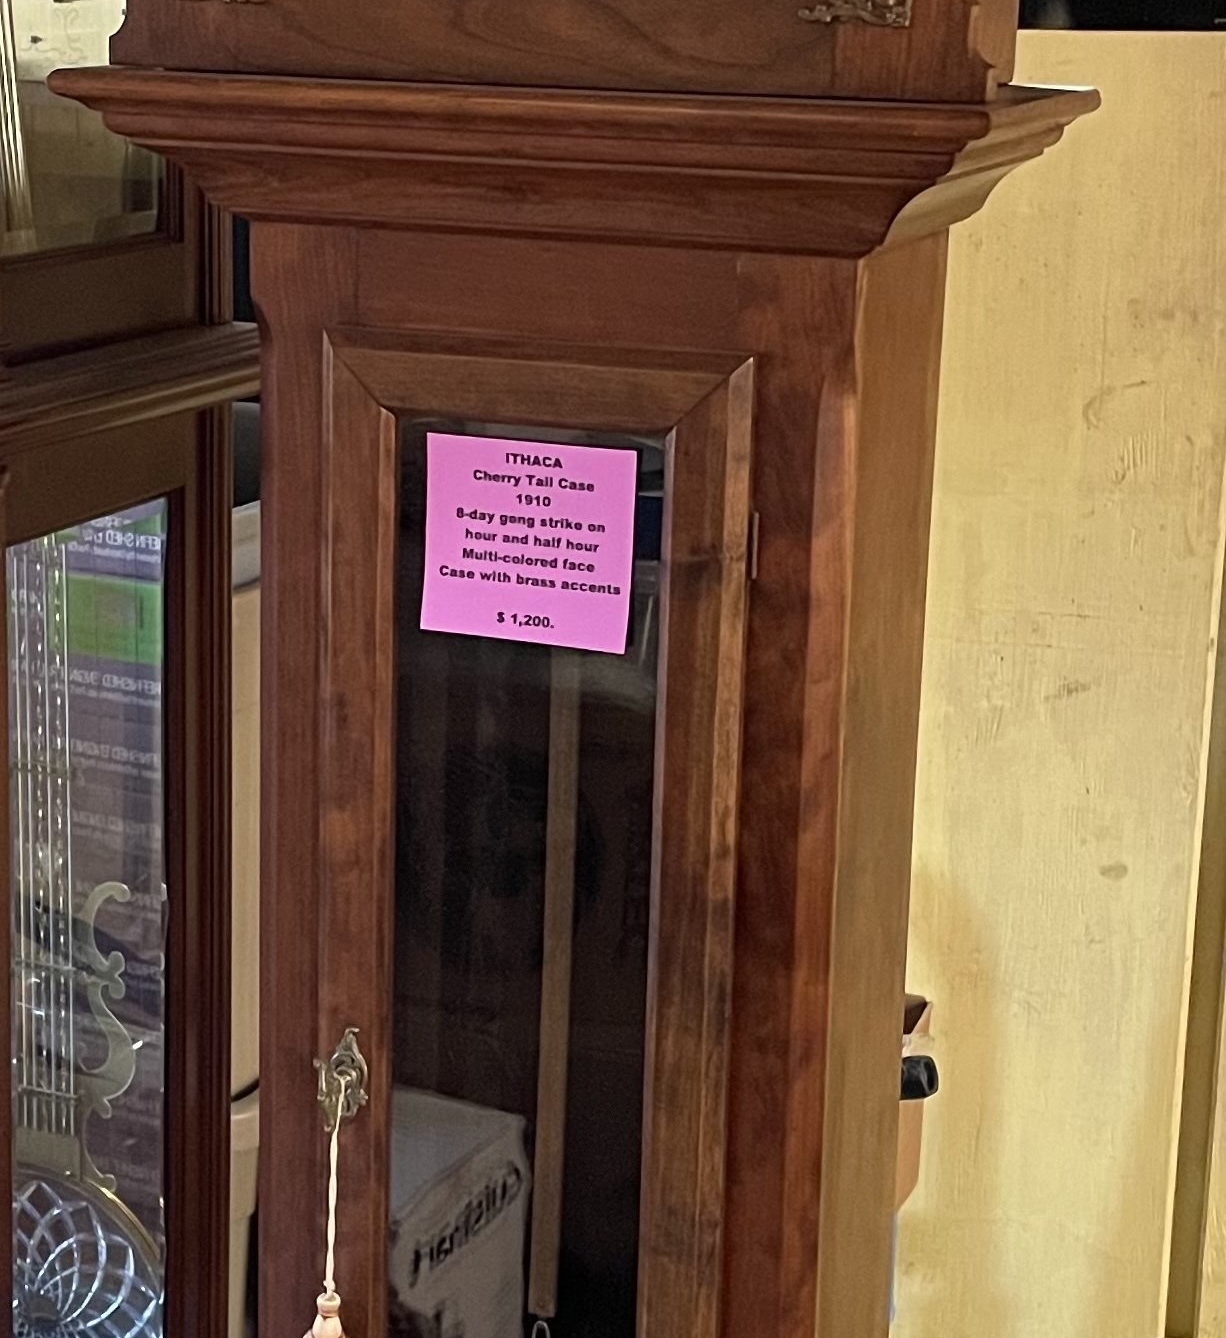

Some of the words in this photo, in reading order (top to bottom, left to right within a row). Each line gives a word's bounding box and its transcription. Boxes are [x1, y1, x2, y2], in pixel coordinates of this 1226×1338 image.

[505, 452, 563, 468] ITHACA
[473, 469, 521, 487] Cherry
[525, 474, 553, 488] Tall
[558, 478, 595, 492] Case
[516, 493, 551, 507] 1910
[456, 507, 495, 524] 8-day
[500, 514, 535, 529] gong
[540, 517, 582, 531] strike
[587, 523, 606, 533] on
[465, 528, 498, 542] hour
[502, 533, 528, 545] and
[533, 535, 562, 548] half
[566, 539, 600, 553] hour
[462, 547, 558, 568] Multi-colored
[562, 558, 596, 573] face
[439, 565, 475, 579] Case
[479, 570, 511, 583] with
[516, 573, 556, 589] brass
[560, 580, 621, 596] accents
[496, 611, 505, 624] $
[511, 613, 555, 629] 1,200.
